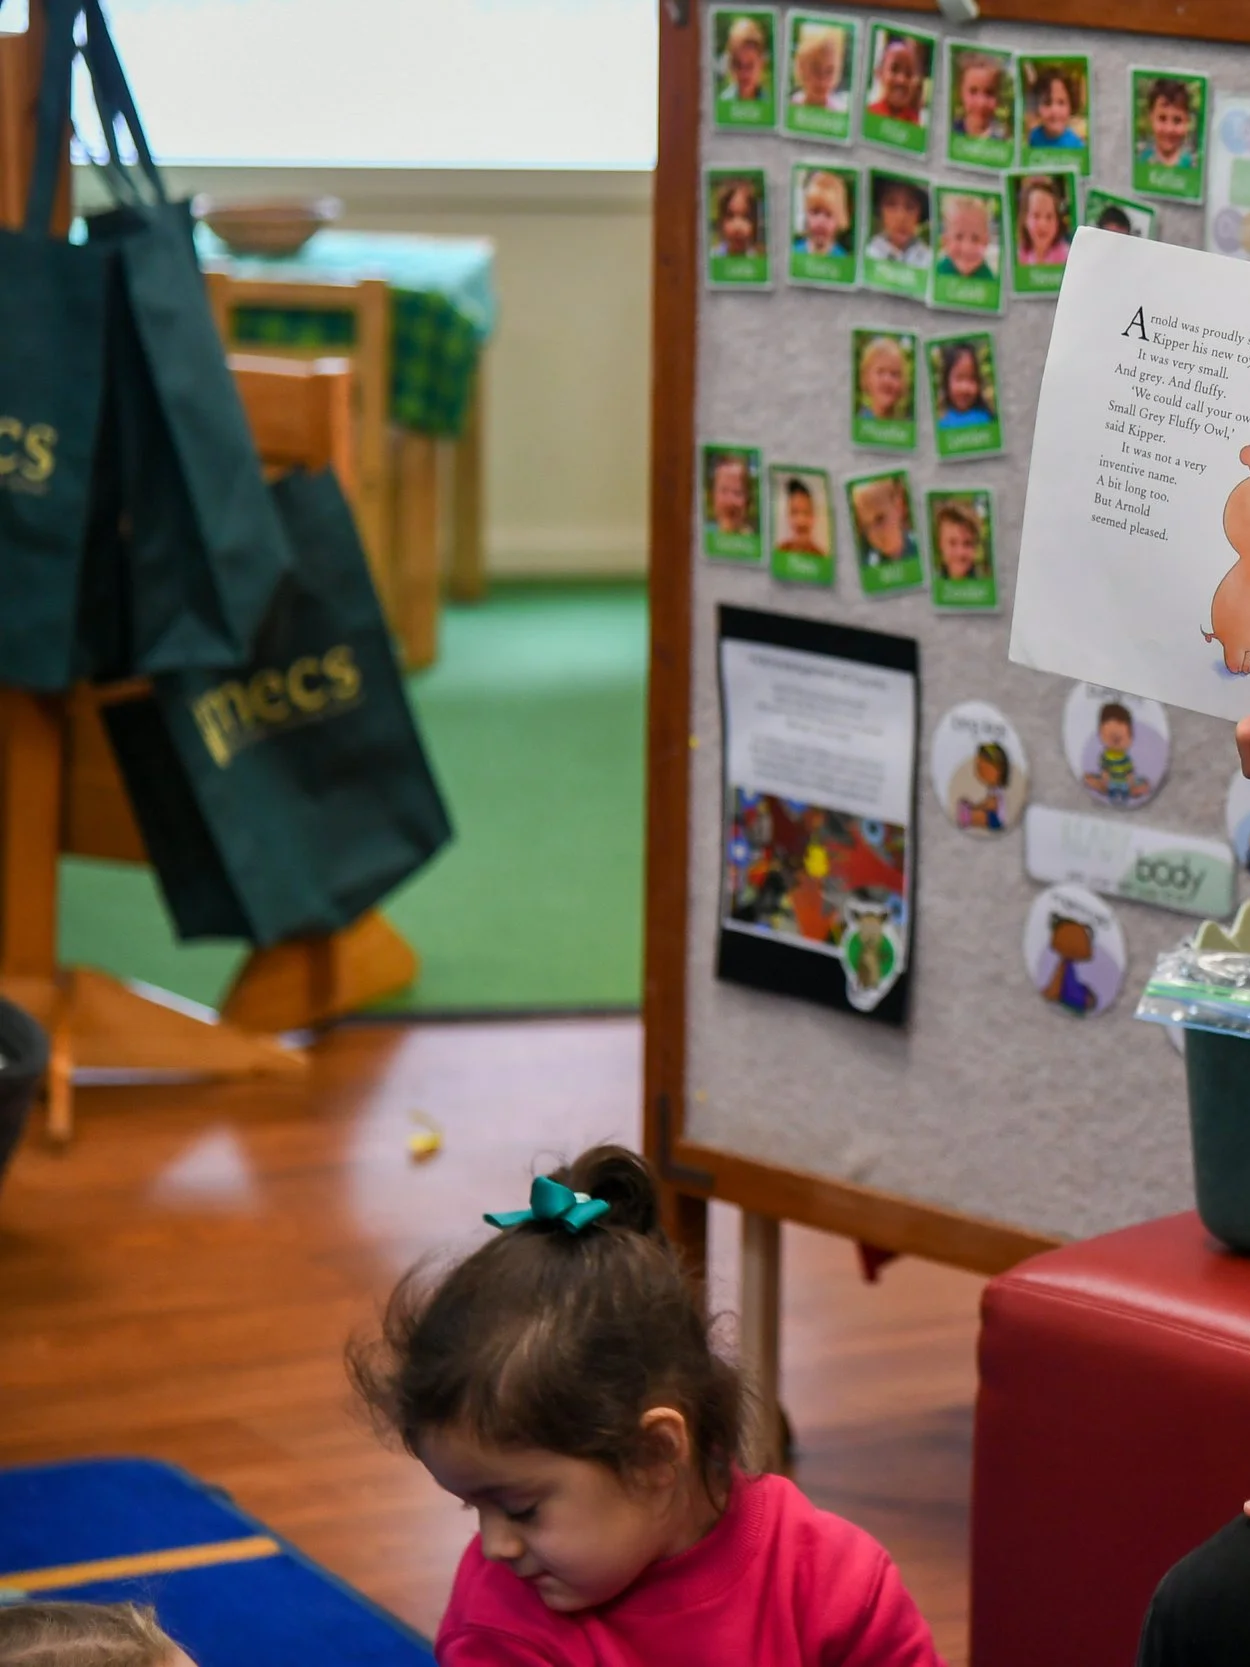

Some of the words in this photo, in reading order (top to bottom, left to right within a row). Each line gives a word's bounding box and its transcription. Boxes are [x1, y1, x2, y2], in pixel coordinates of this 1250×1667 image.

[1152, 332, 1190, 351] Kipper
[1192, 340, 1208, 355] his
[1211, 349, 1234, 360] new
[1181, 322, 1200, 334] was
[1201, 327, 1245, 346] proudly
[1137, 348, 1147, 360] It
[1150, 354, 1169, 365] was
[1172, 359, 1196, 374] very
[1198, 366, 1229, 380] small.
[1114, 363, 1137, 378] And
[1138, 372, 1165, 386] grey.
[1167, 376, 1192, 390] And
[1194, 380, 1226, 401] fluffy.
[1108, 399, 1136, 417] Small
[1139, 407, 1166, 426] Grey
[1168, 414, 1201, 435] Fluffy
[1153, 394, 1183, 408] could
[1185, 400, 1205, 413] call
[1205, 407, 1233, 419] your
[1105, 420, 1125, 433] said
[1128, 423, 1166, 443] Kipper.
[1099, 454, 1145, 477] inventive
[1148, 471, 1177, 485] name.
[1121, 441, 1130, 454] It
[1133, 448, 1152, 459] was
[1154, 453, 1172, 464] not
[1175, 458, 1181, 466] a
[1184, 460, 1207, 475] very
[1096, 474, 1105, 486] A
[1108, 475, 1122, 490] bit
[1124, 480, 1147, 500] long
[1150, 490, 1169, 503] too.
[1094, 492, 1112, 507] But
[1115, 498, 1151, 517] Arnold
[1091, 514, 1127, 530] seemed
[1129, 521, 1168, 541] pleased.
[1135, 851, 1206, 899] body
